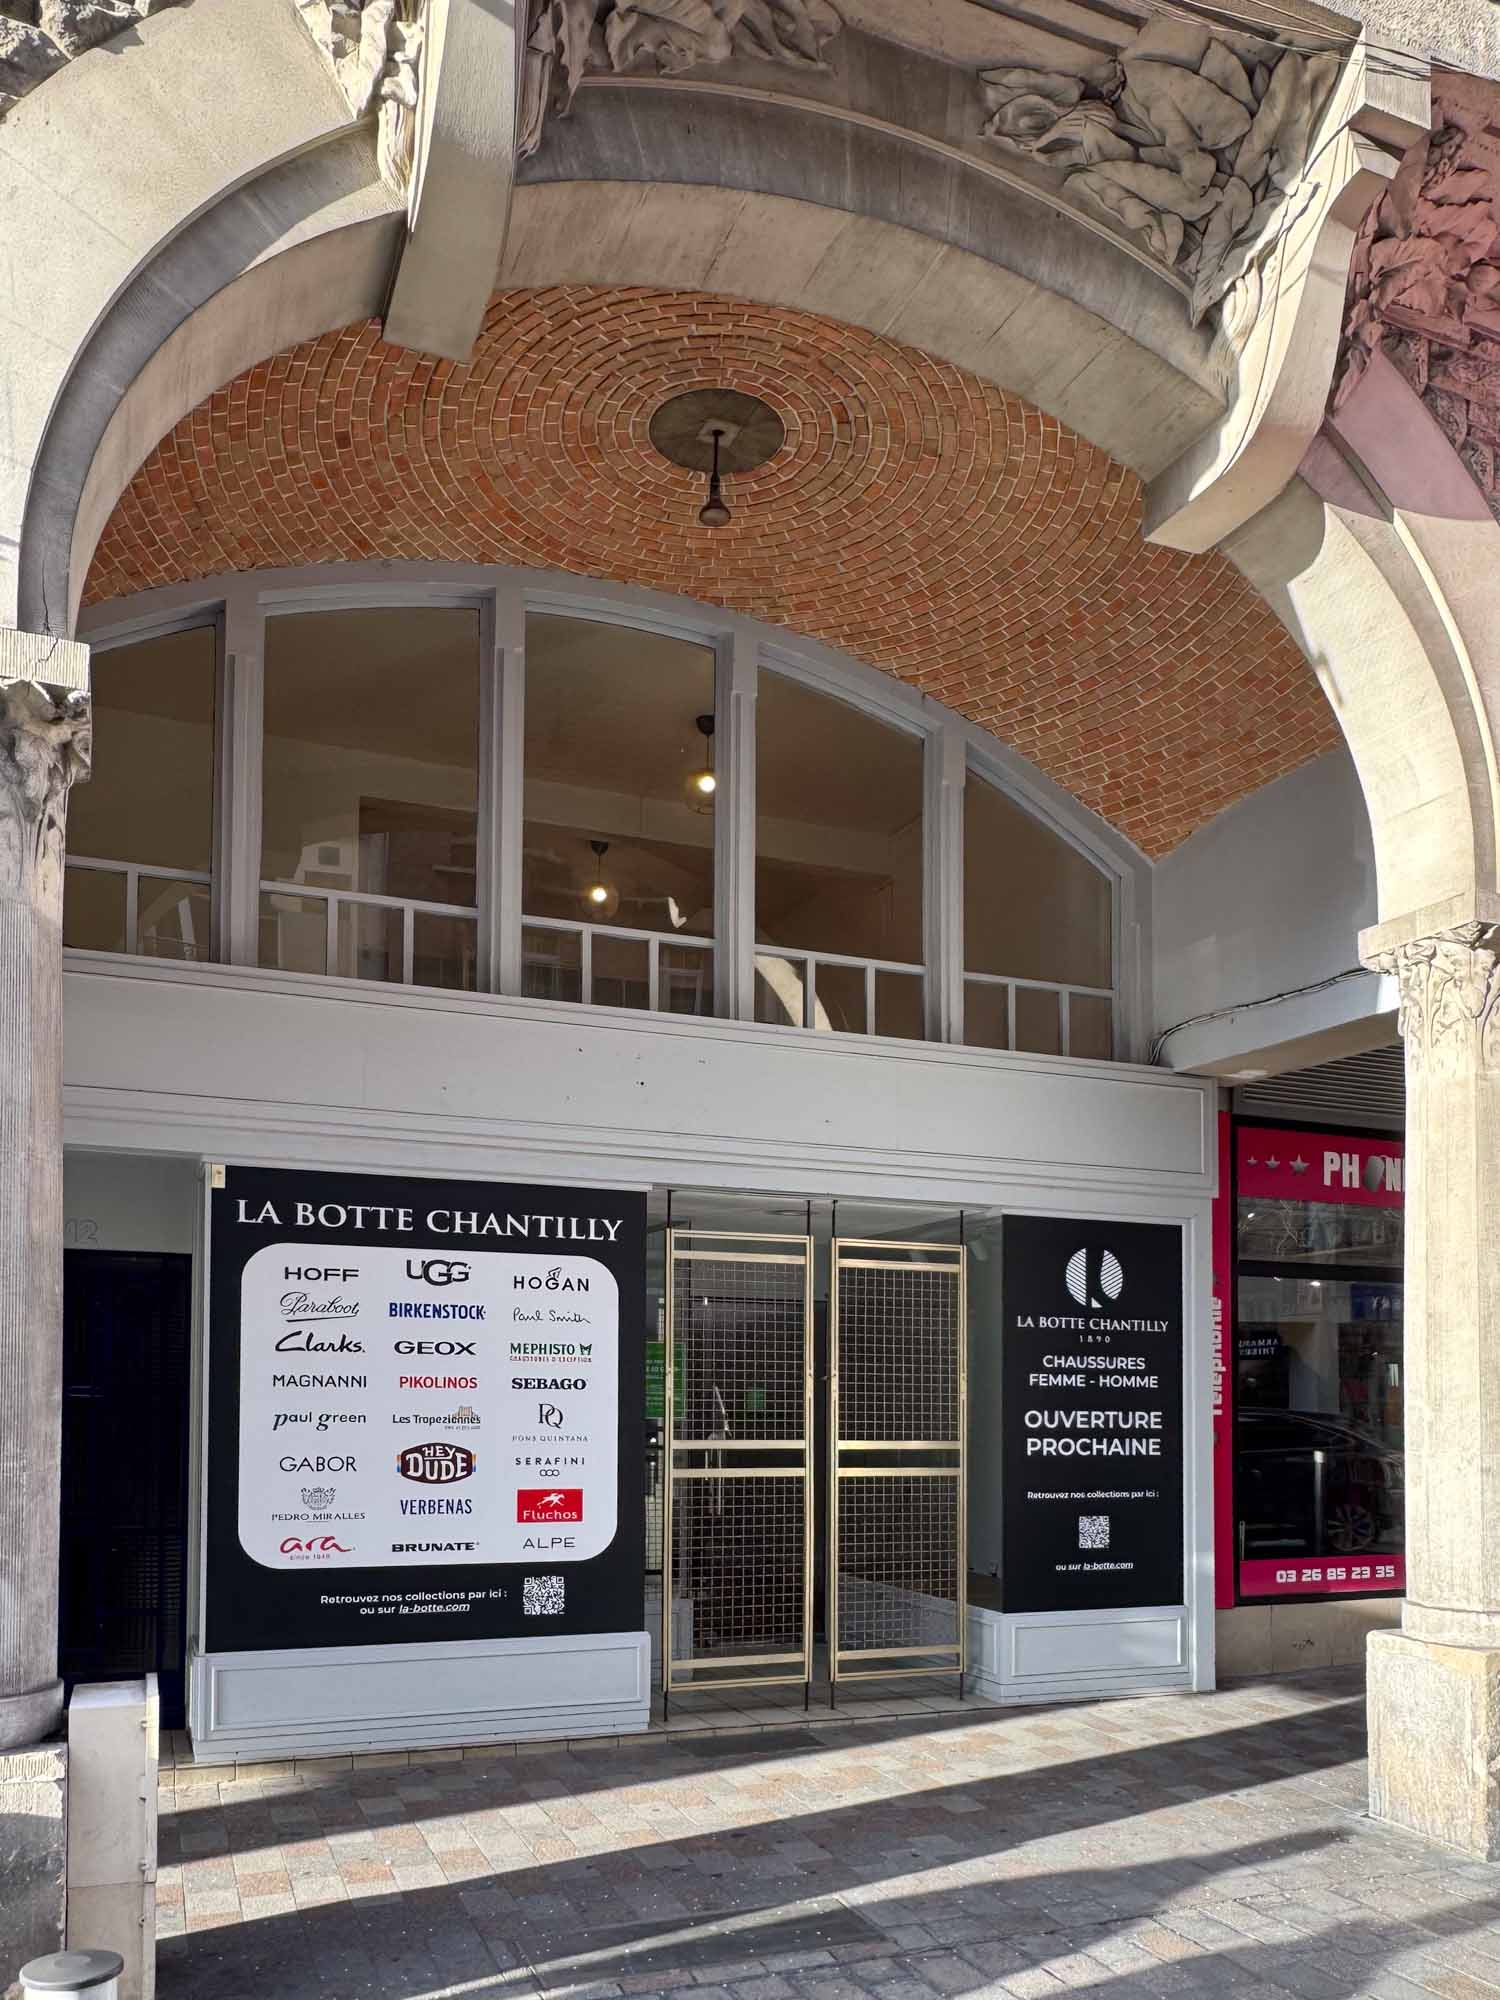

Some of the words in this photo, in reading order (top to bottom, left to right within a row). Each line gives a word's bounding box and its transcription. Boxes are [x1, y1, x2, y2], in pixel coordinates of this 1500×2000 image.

[237, 1199, 282, 1225] LA
[295, 1202, 414, 1231] BOTTE
[426, 1209, 624, 1241] CHANTILLY
[284, 1266, 360, 1281] HOFF
[406, 1259, 470, 1287] UGG
[513, 1275, 590, 1292] HOGAN
[280, 1291, 360, 1320] Paraboot
[389, 1302, 485, 1320] BIRKENSTOCK
[513, 1306, 543, 1321] Paul
[549, 1309, 592, 1324] Smith
[1016, 1315, 1035, 1328] LA
[1039, 1316, 1086, 1329] BOTTE
[1089, 1317, 1169, 1333] CHANTILLY
[394, 1340, 477, 1356] GEOX
[510, 1342, 575, 1355] MEPHISTO
[1042, 1355, 1146, 1370] CHAUSSURES
[272, 1374, 367, 1388] MAGNANNI
[399, 1375, 478, 1389] PIKOLINOS
[511, 1377, 587, 1391] SEBAGO
[1029, 1373, 1086, 1387] FEMME
[1099, 1375, 1159, 1388] HOMME
[272, 1411, 312, 1431] paul
[316, 1413, 367, 1432] green
[392, 1414, 411, 1424] Les
[1024, 1410, 1163, 1429] OUVERTURE
[422, 1445, 456, 1458] HEY
[1026, 1438, 1161, 1456] PROCHAINE
[279, 1456, 357, 1472] GABOR
[405, 1452, 468, 1481] DUDE
[515, 1456, 586, 1466] SERAFINI
[1027, 1490, 1069, 1499] Retrouvez
[1070, 1490, 1085, 1499] nos
[1087, 1490, 1130, 1499] collections
[1131, 1490, 1144, 1499] par
[400, 1499, 473, 1515] VERBENAS
[272, 1513, 310, 1521] PEDRO
[312, 1512, 366, 1521] MIRALLES
[523, 1509, 578, 1521] Fluchos
[279, 1535, 353, 1554] ara
[391, 1542, 475, 1553] BRUNATE
[523, 1536, 576, 1550] ALPE
[1056, 1563, 1067, 1571] ou
[1068, 1563, 1081, 1571] sur
[1083, 1561, 1134, 1571] la-botte.com
[1276, 1570, 1297, 1583] 03
[1301, 1568, 1321, 1582] 26
[1326, 1567, 1346, 1580] 85
[1351, 1566, 1371, 1579] 23
[1375, 1565, 1394, 1578] 35
[320, 1594, 379, 1604] Retrouvez
[382, 1594, 403, 1603] nos
[405, 1591, 466, 1602] collections
[468, 1590, 487, 1600] par
[360, 1606, 375, 1615] ou
[377, 1606, 396, 1615] sur
[399, 1602, 471, 1615] la-botte.com
